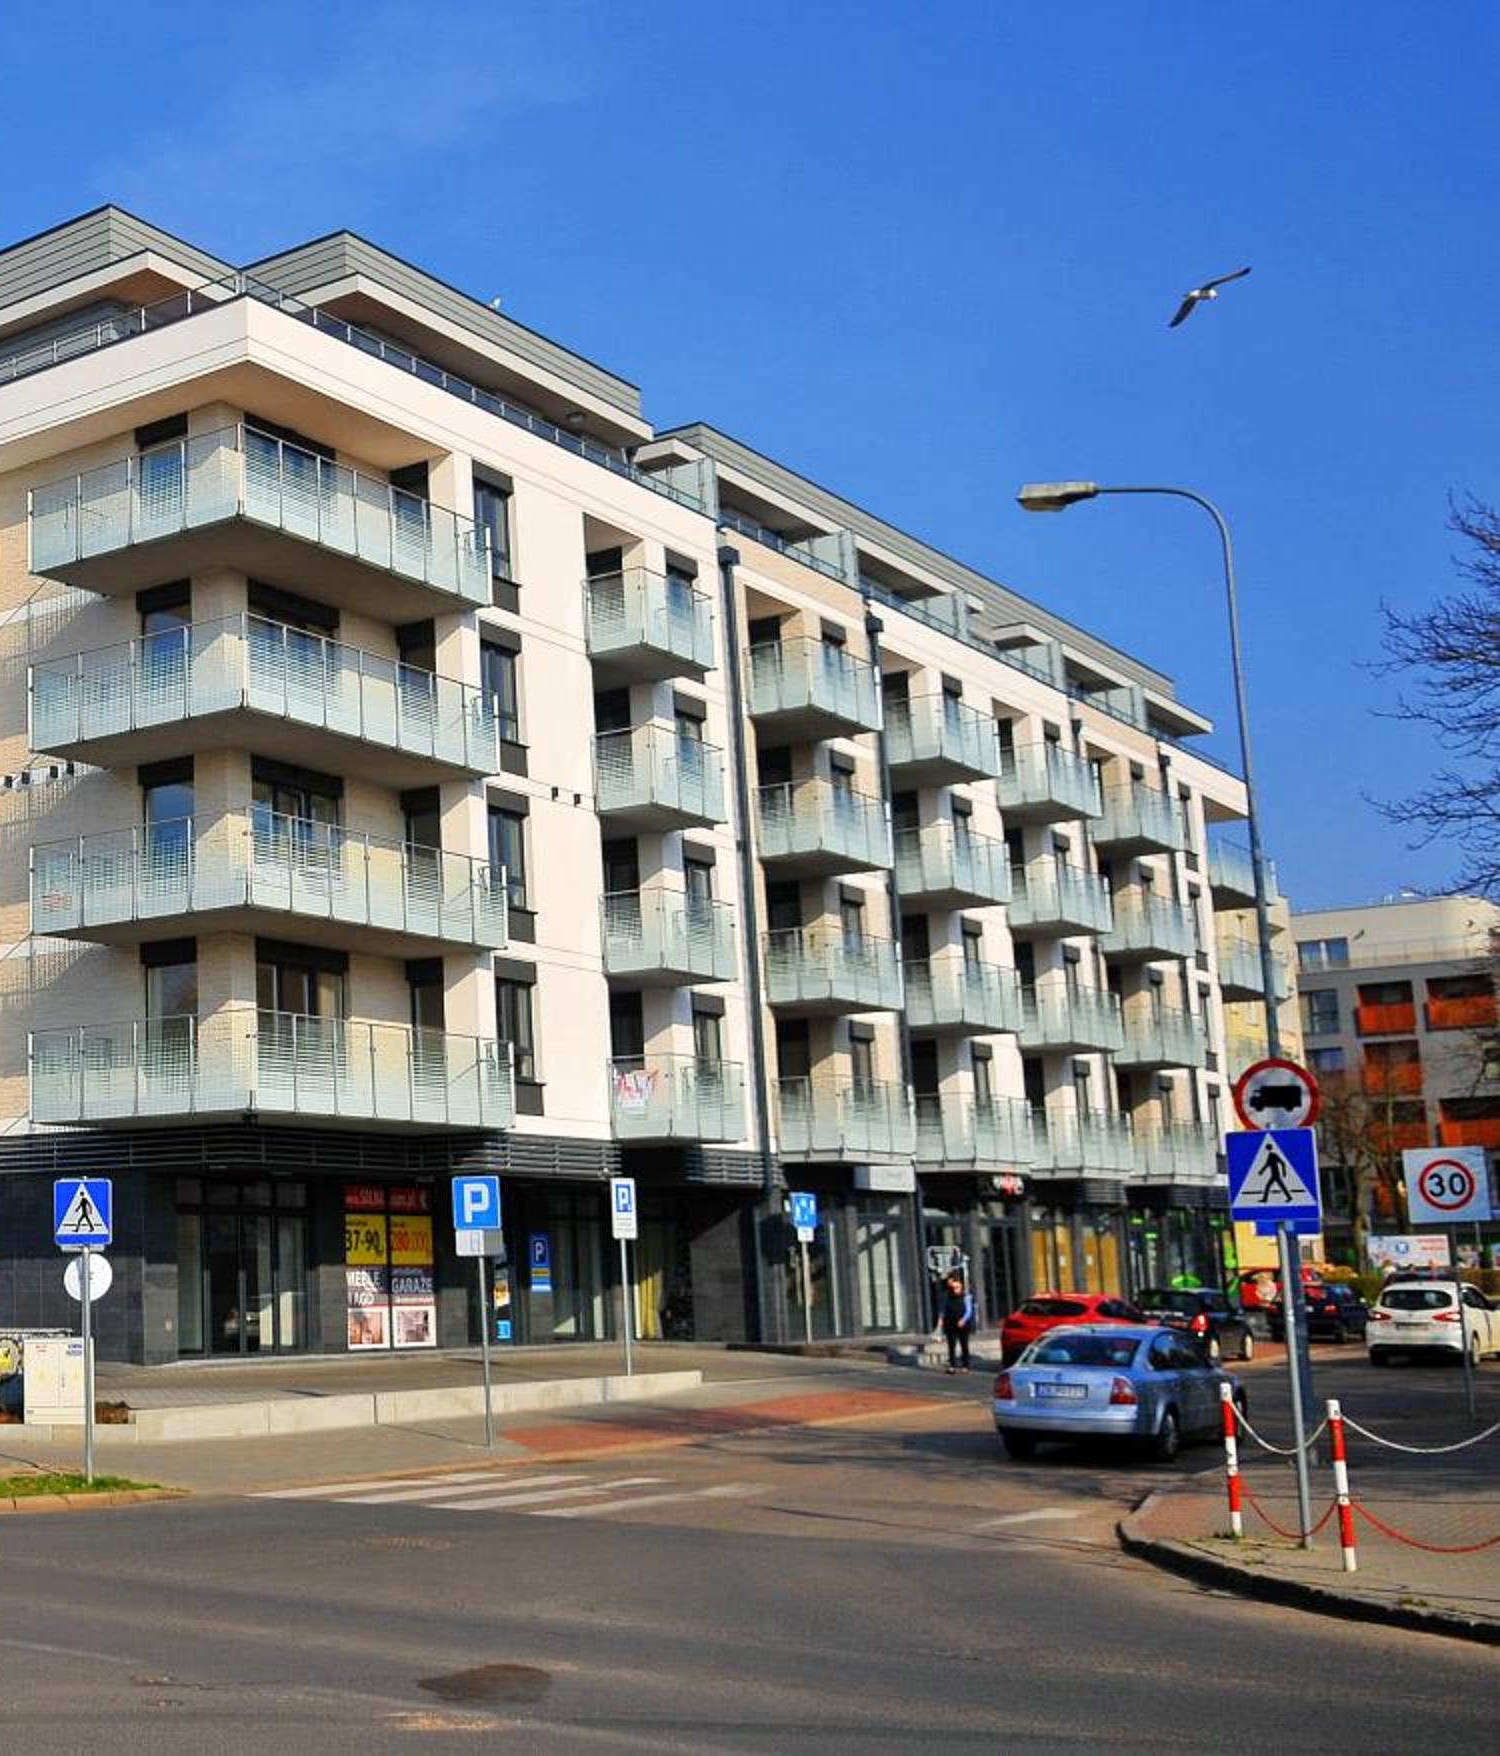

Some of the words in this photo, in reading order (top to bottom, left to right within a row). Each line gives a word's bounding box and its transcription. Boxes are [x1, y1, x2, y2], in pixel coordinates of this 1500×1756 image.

[1428, 1172, 1467, 1197] 30
[463, 1182, 490, 1224] P
[617, 1187, 630, 1211] P
[534, 1240, 545, 1262] P
